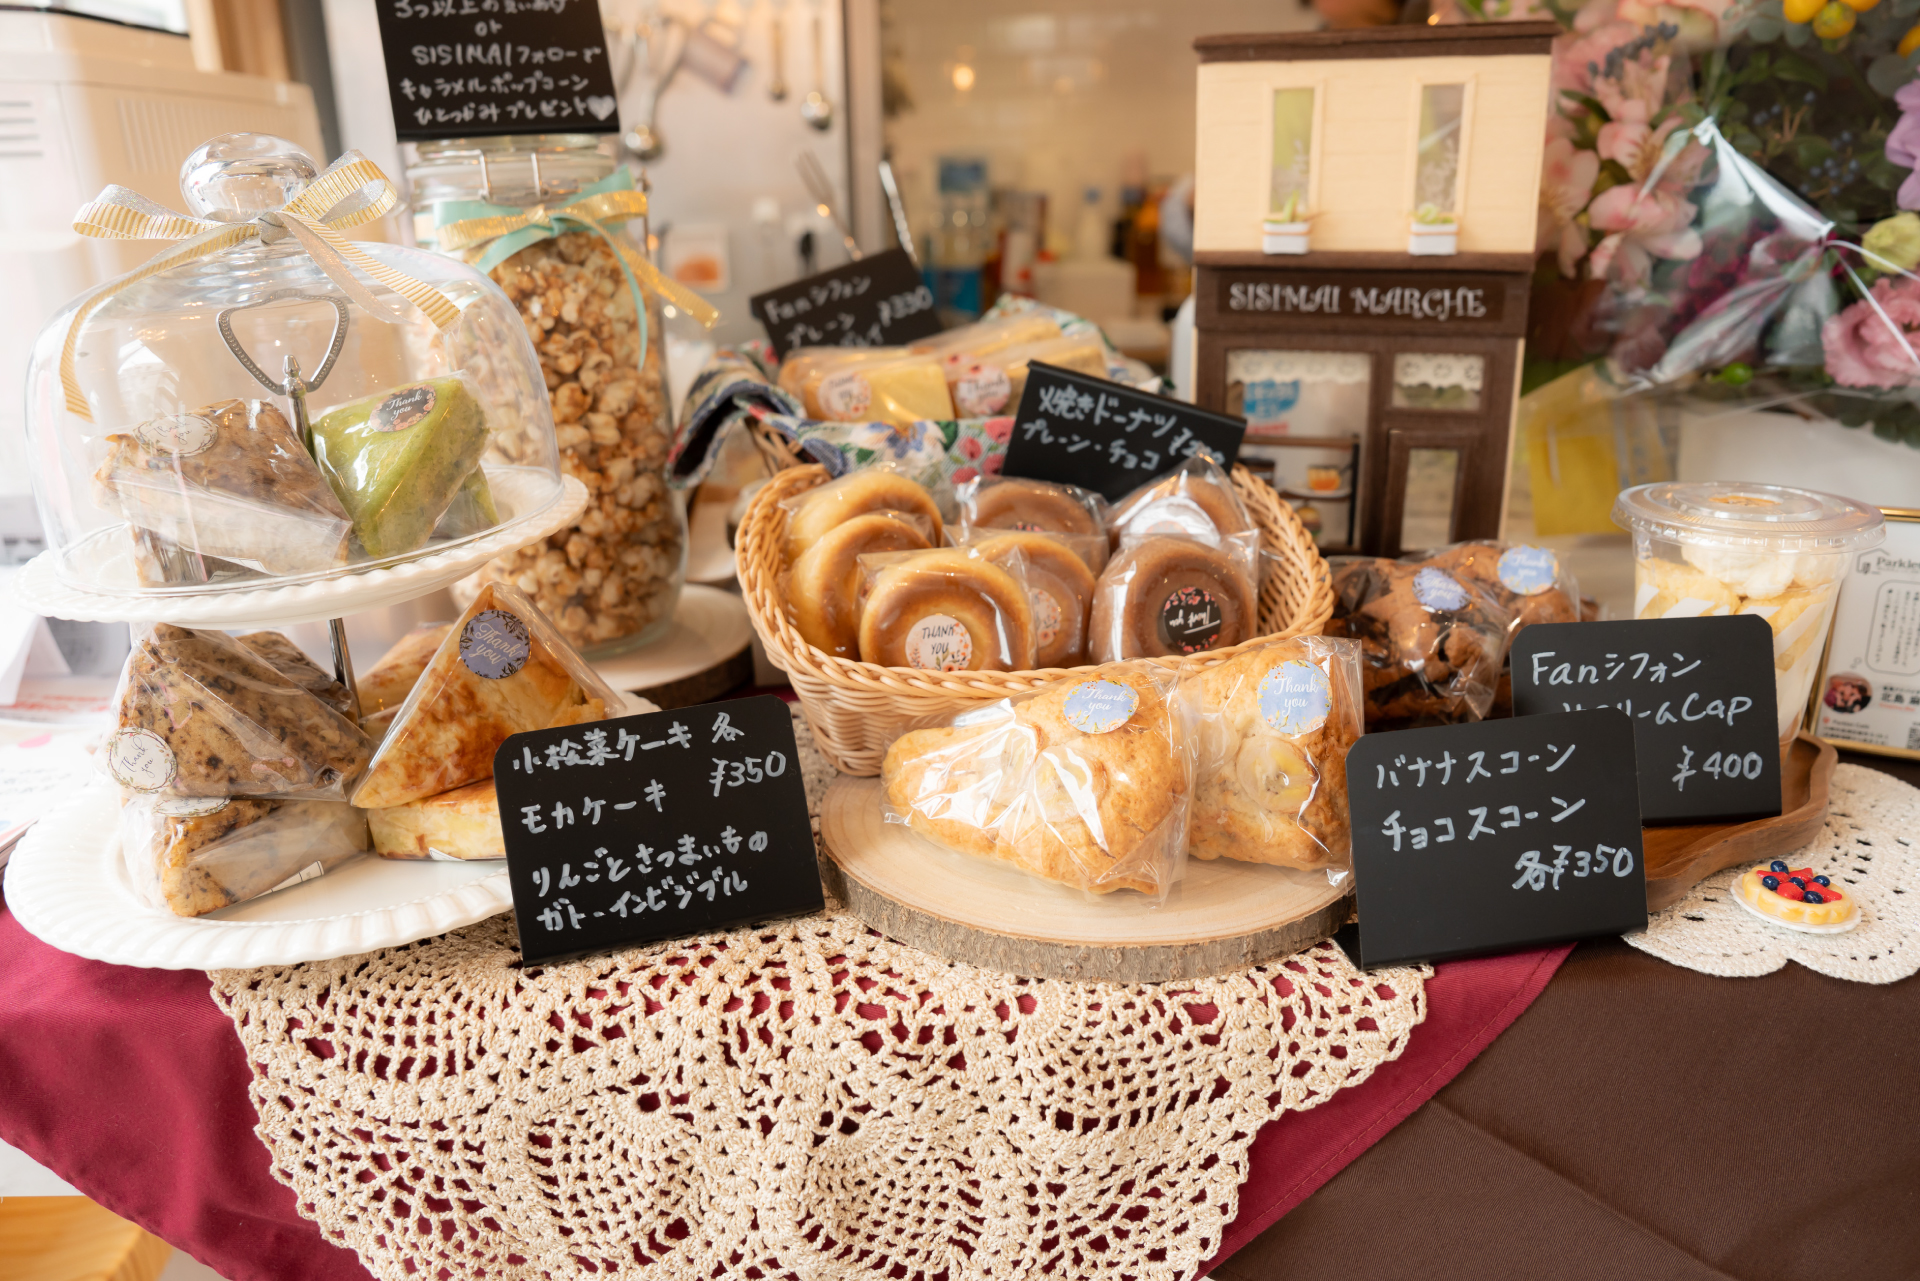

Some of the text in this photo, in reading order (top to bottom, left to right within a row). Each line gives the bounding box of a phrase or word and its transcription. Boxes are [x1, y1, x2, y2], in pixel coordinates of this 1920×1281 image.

[399, 70, 589, 101] キャラメルポップコーン
[1229, 282, 1487, 321] SISIMAI MARCHE
[386, 389, 423, 411] Thank
[391, 404, 413, 421] you
[1038, 382, 1177, 438] 焼きドーナツ
[1510, 553, 1548, 569] Thank
[475, 622, 524, 658] Thank
[922, 624, 956, 640] THANK
[931, 642, 950, 655] YOU
[469, 643, 508, 665] you
[1531, 650, 1702, 686] Fanシフォン
[1082, 688, 1127, 702] Thank
[1274, 673, 1319, 695] Thank
[1083, 702, 1112, 717] you
[1281, 698, 1309, 718] you
[118, 735, 149, 773] Thank
[512, 721, 692, 774] 小松菜ケーキ
[140, 757, 156, 779] you
[709, 751, 787, 797] ¥350
[1376, 743, 1577, 790] バナナスコーン
[521, 779, 667, 834] モカケーキ
[1381, 797, 1586, 852] チョコスコーン
[532, 825, 769, 897] りんごとさつまいもの
[536, 866, 748, 931] ガトーインビジブル
